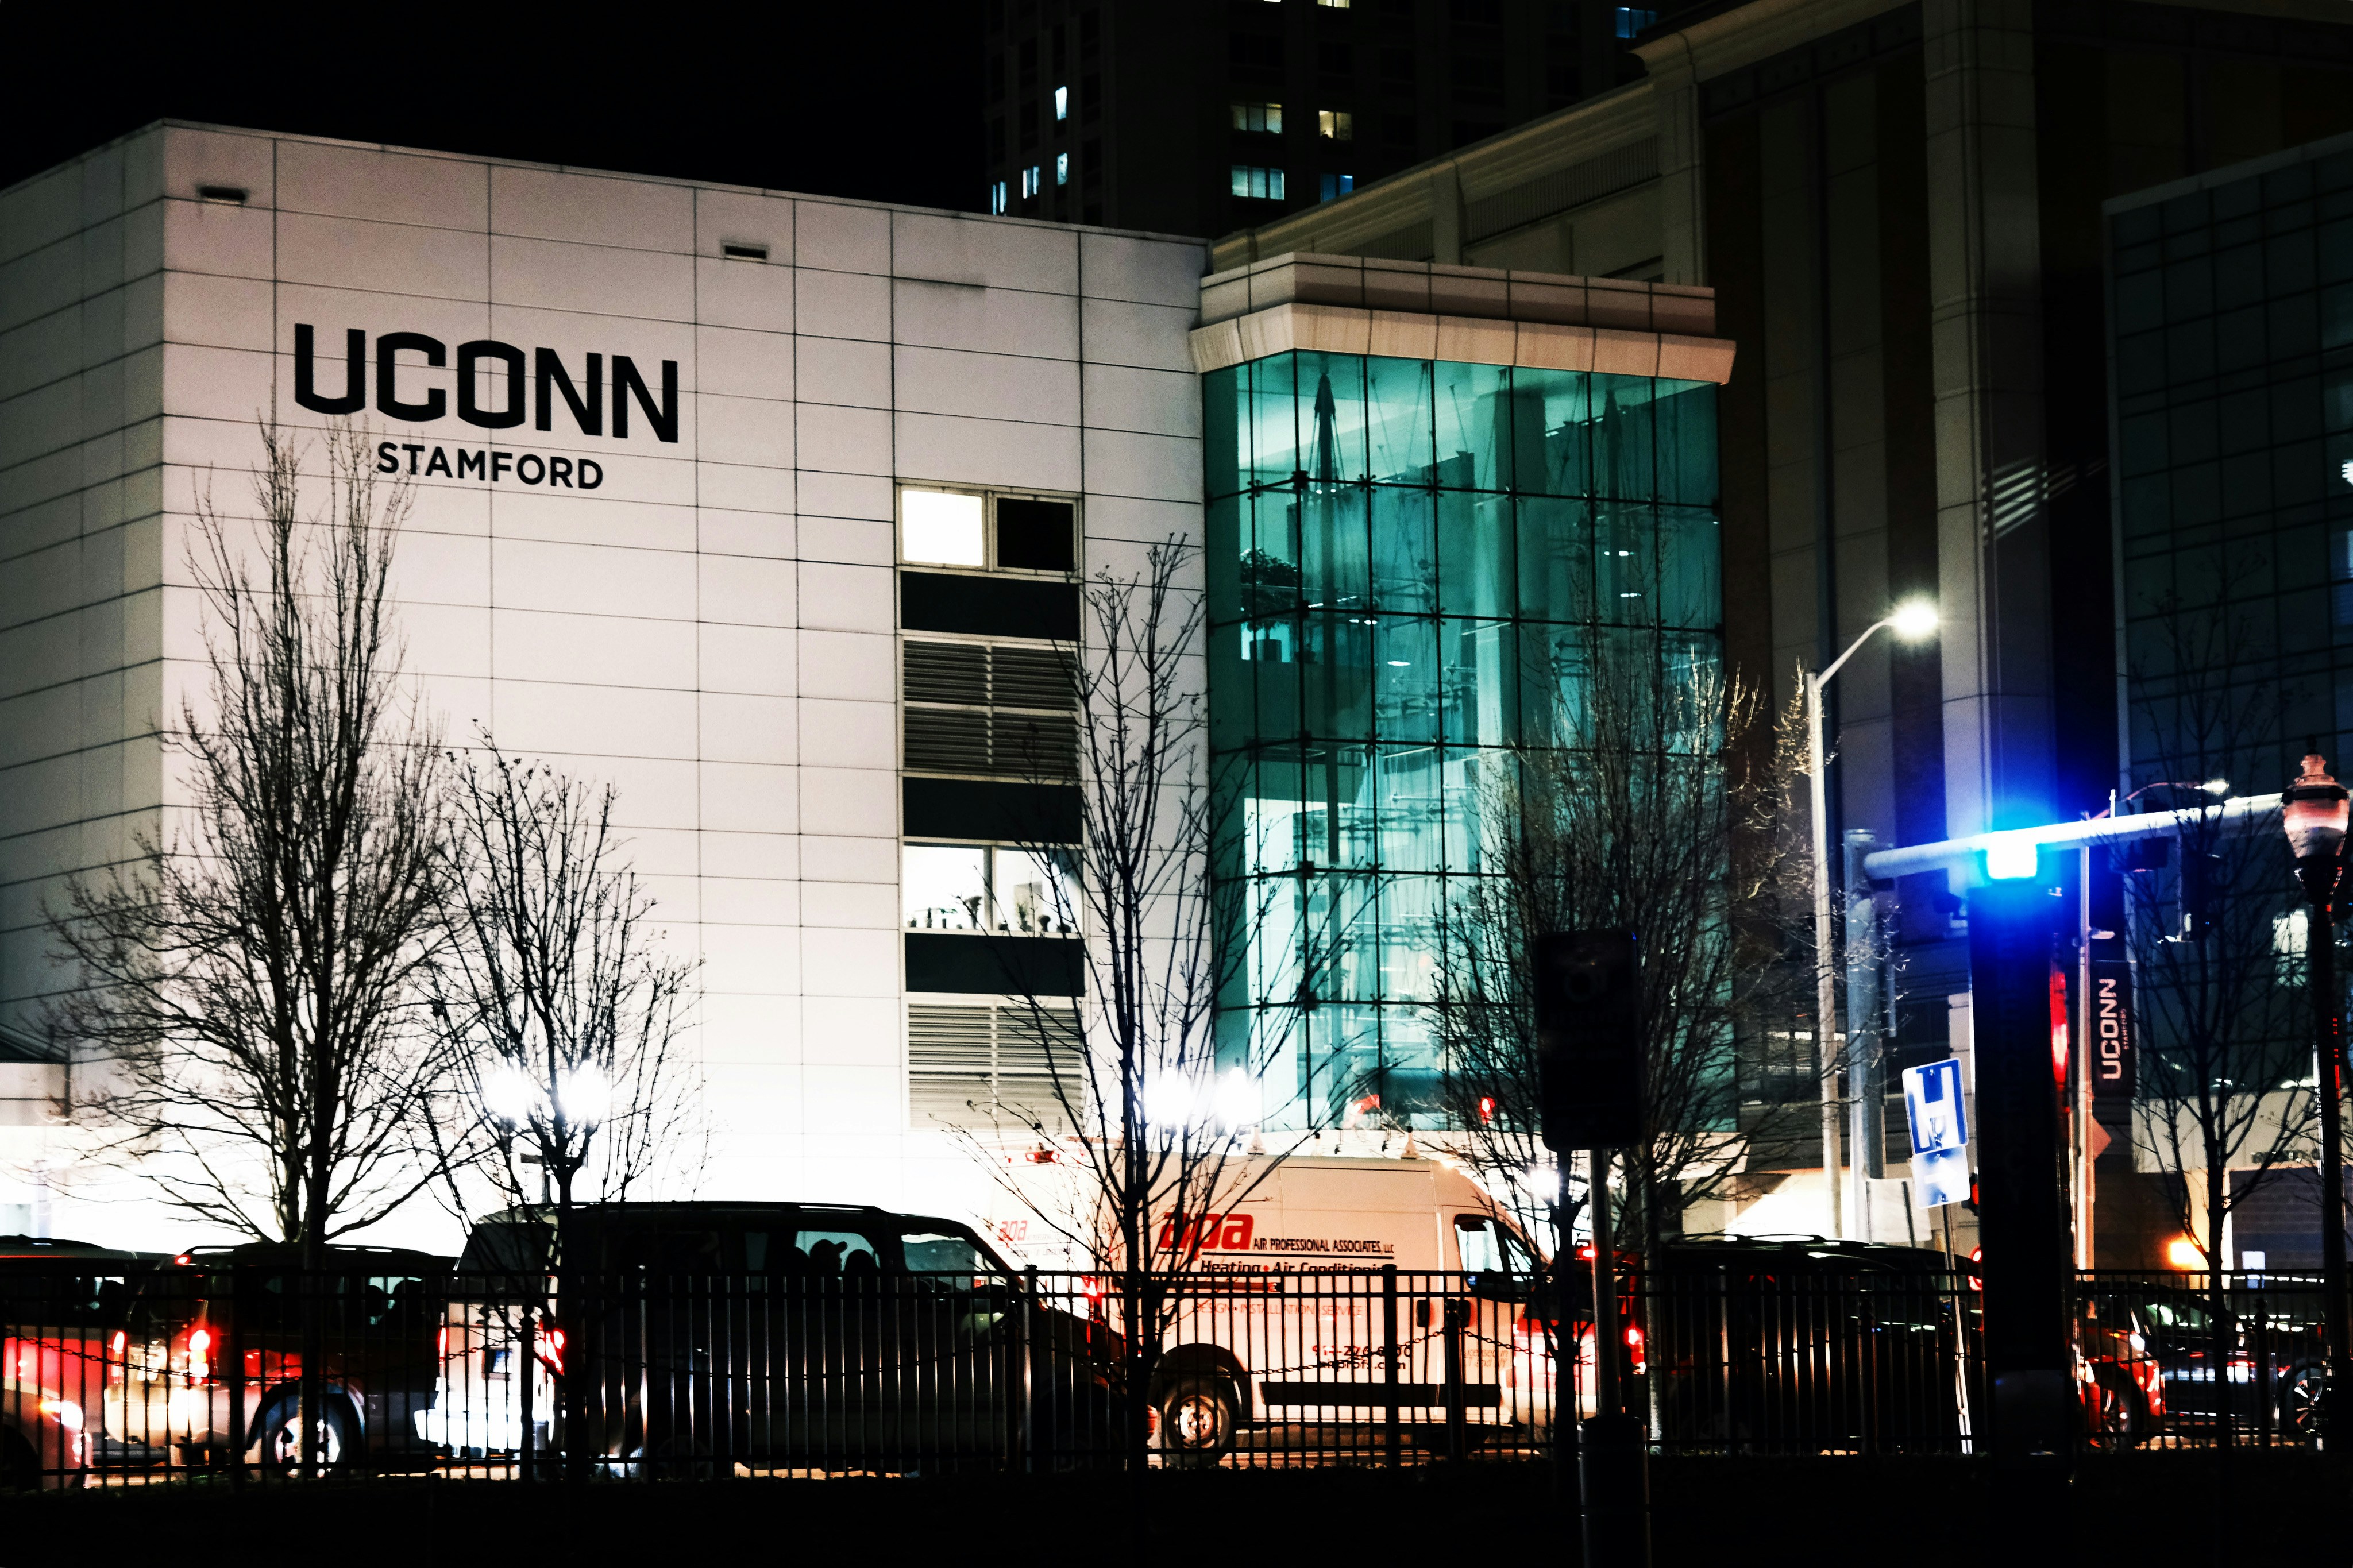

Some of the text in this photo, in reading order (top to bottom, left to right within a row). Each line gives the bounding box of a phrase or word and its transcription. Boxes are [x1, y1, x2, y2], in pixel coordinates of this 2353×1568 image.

[295, 323, 678, 443] UCONN
[377, 442, 604, 489] STAMFORD
[2098, 979, 2123, 1079] UCONN
[1916, 1066, 1959, 1149] H
[1160, 1212, 1254, 1261] apa
[1253, 1238, 1267, 1250] AIR
[1270, 1238, 1330, 1252] PROFESSIONAL
[1333, 1240, 1383, 1254] ASSOCIATES,
[1273, 1261, 1295, 1275] Air
[1300, 1262, 1384, 1275] Conditionin
